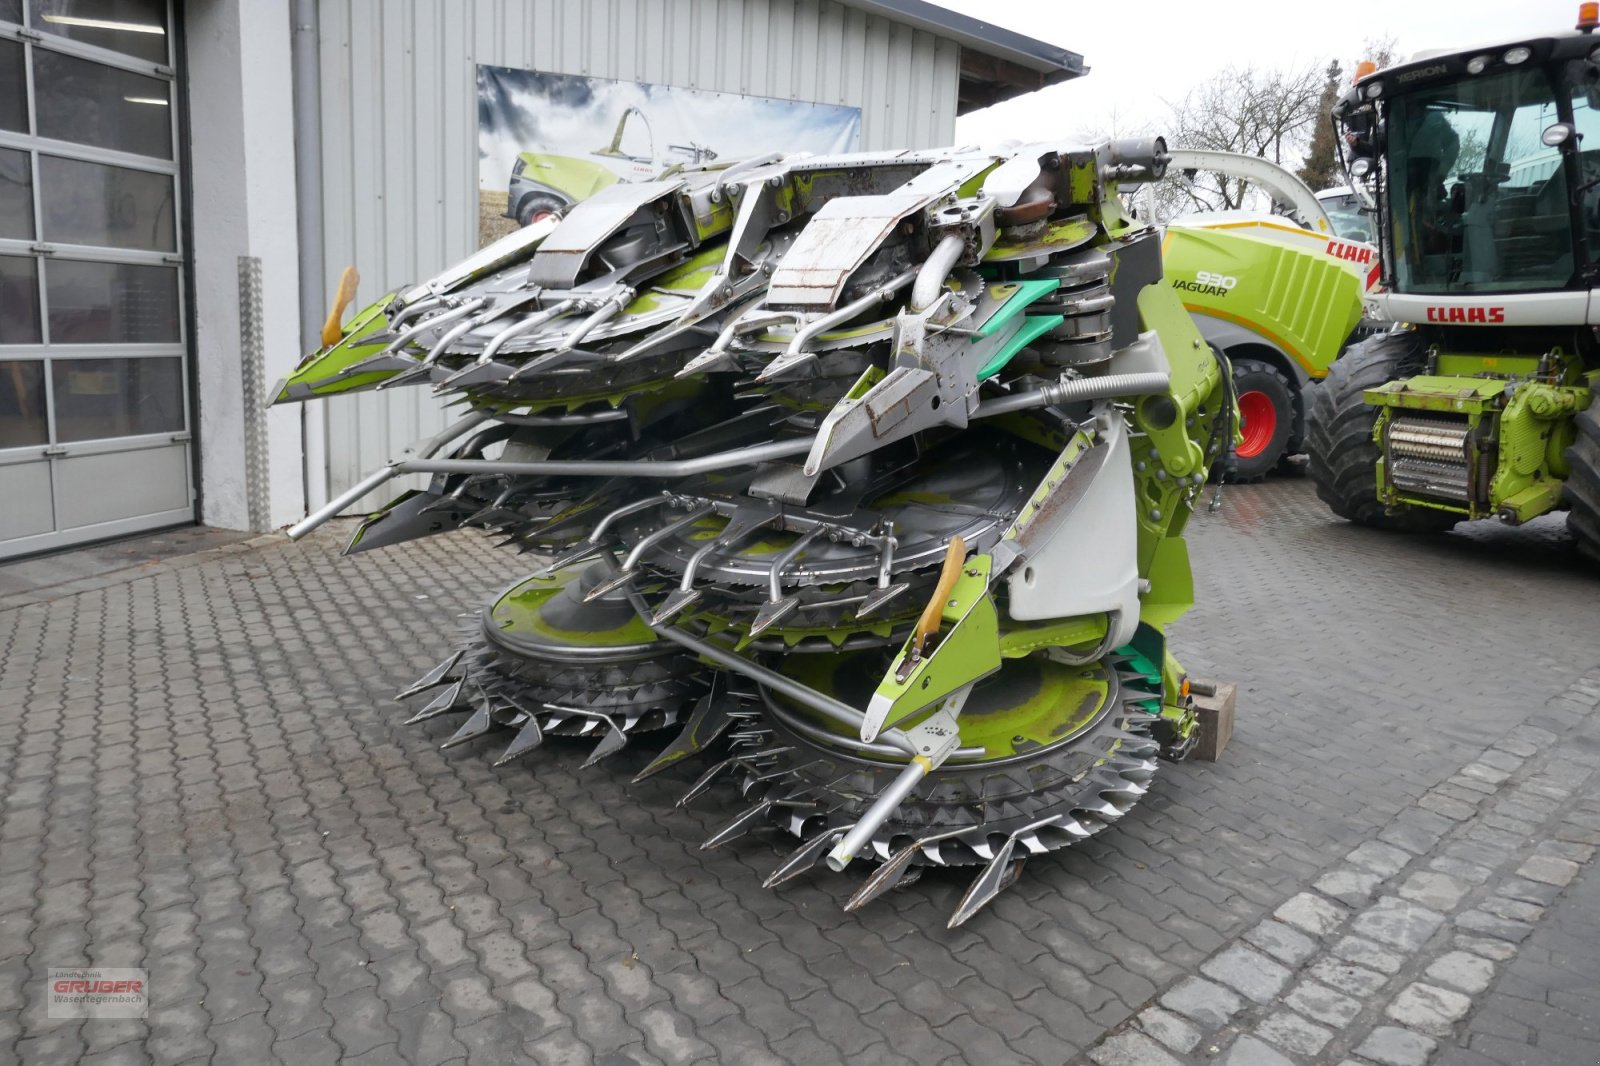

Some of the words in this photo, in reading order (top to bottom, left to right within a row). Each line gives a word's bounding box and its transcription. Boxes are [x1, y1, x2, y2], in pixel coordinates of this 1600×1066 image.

[1326, 241, 1376, 265] CLAA
[1172, 279, 1228, 298] JAGUAR
[1195, 271, 1237, 290] 930
[1427, 307, 1504, 323] CLAAS
